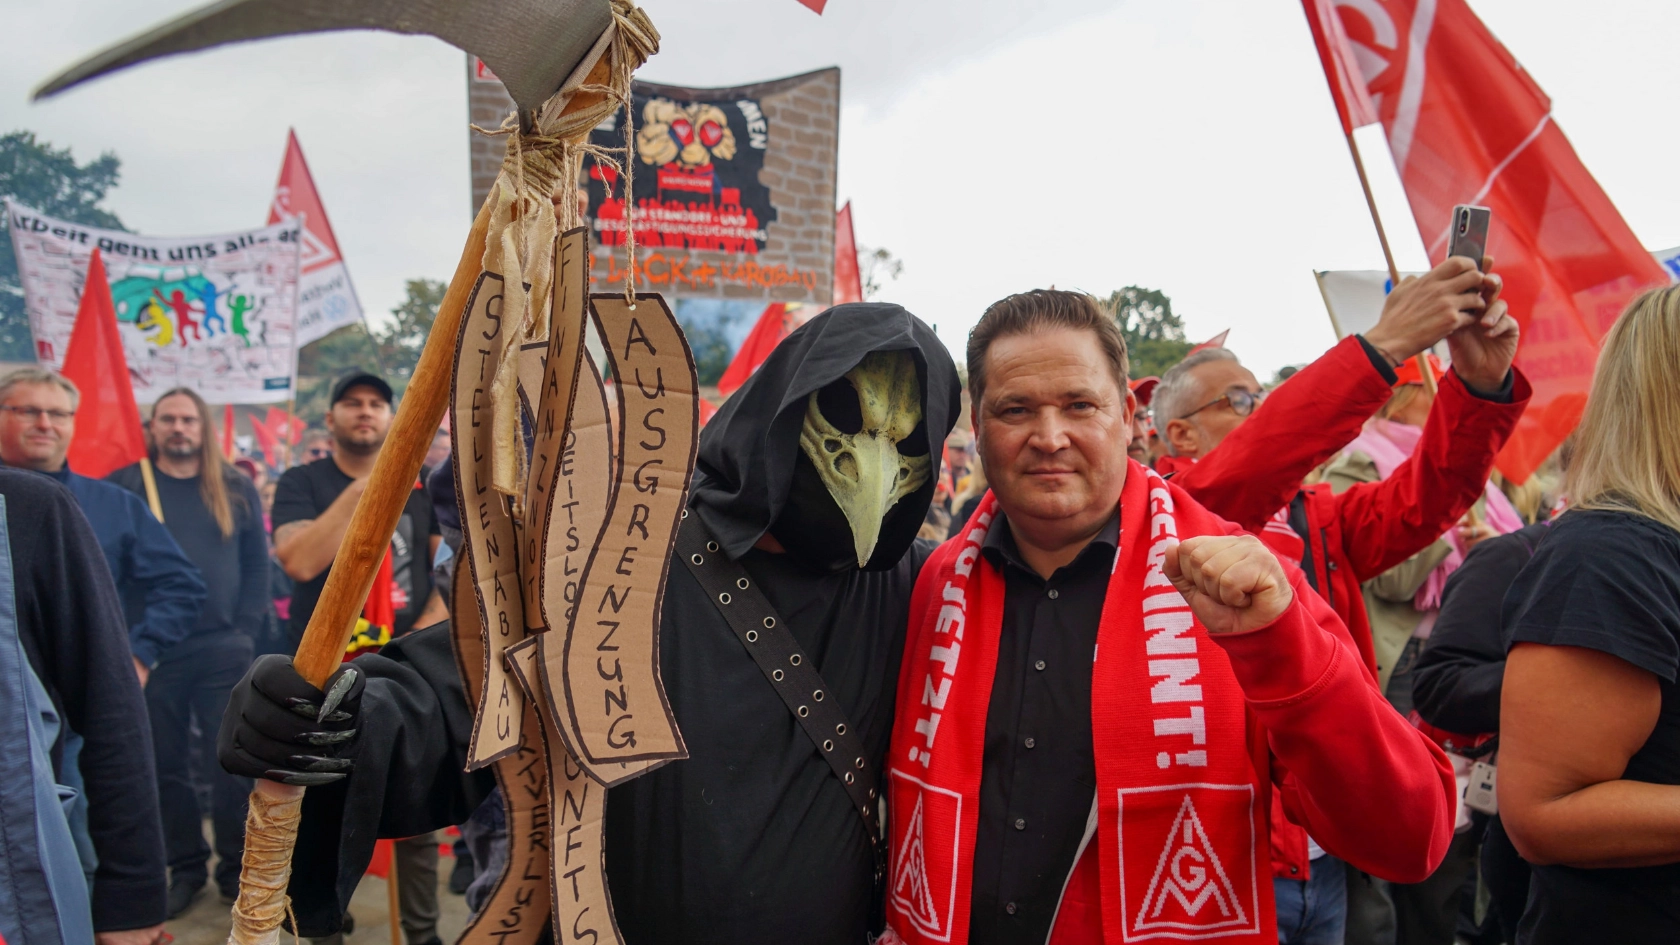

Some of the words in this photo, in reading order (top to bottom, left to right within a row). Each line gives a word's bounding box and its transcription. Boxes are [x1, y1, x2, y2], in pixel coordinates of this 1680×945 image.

[168, 243, 217, 262] uns
[607, 253, 692, 286] LACK
[721, 213, 747, 227] UND
[528, 242, 574, 605] FINANZNOT
[596, 317, 667, 749] AUSGRENZUNG
[908, 580, 967, 769] JETZT!
[1142, 487, 1208, 770] GEWINNT!
